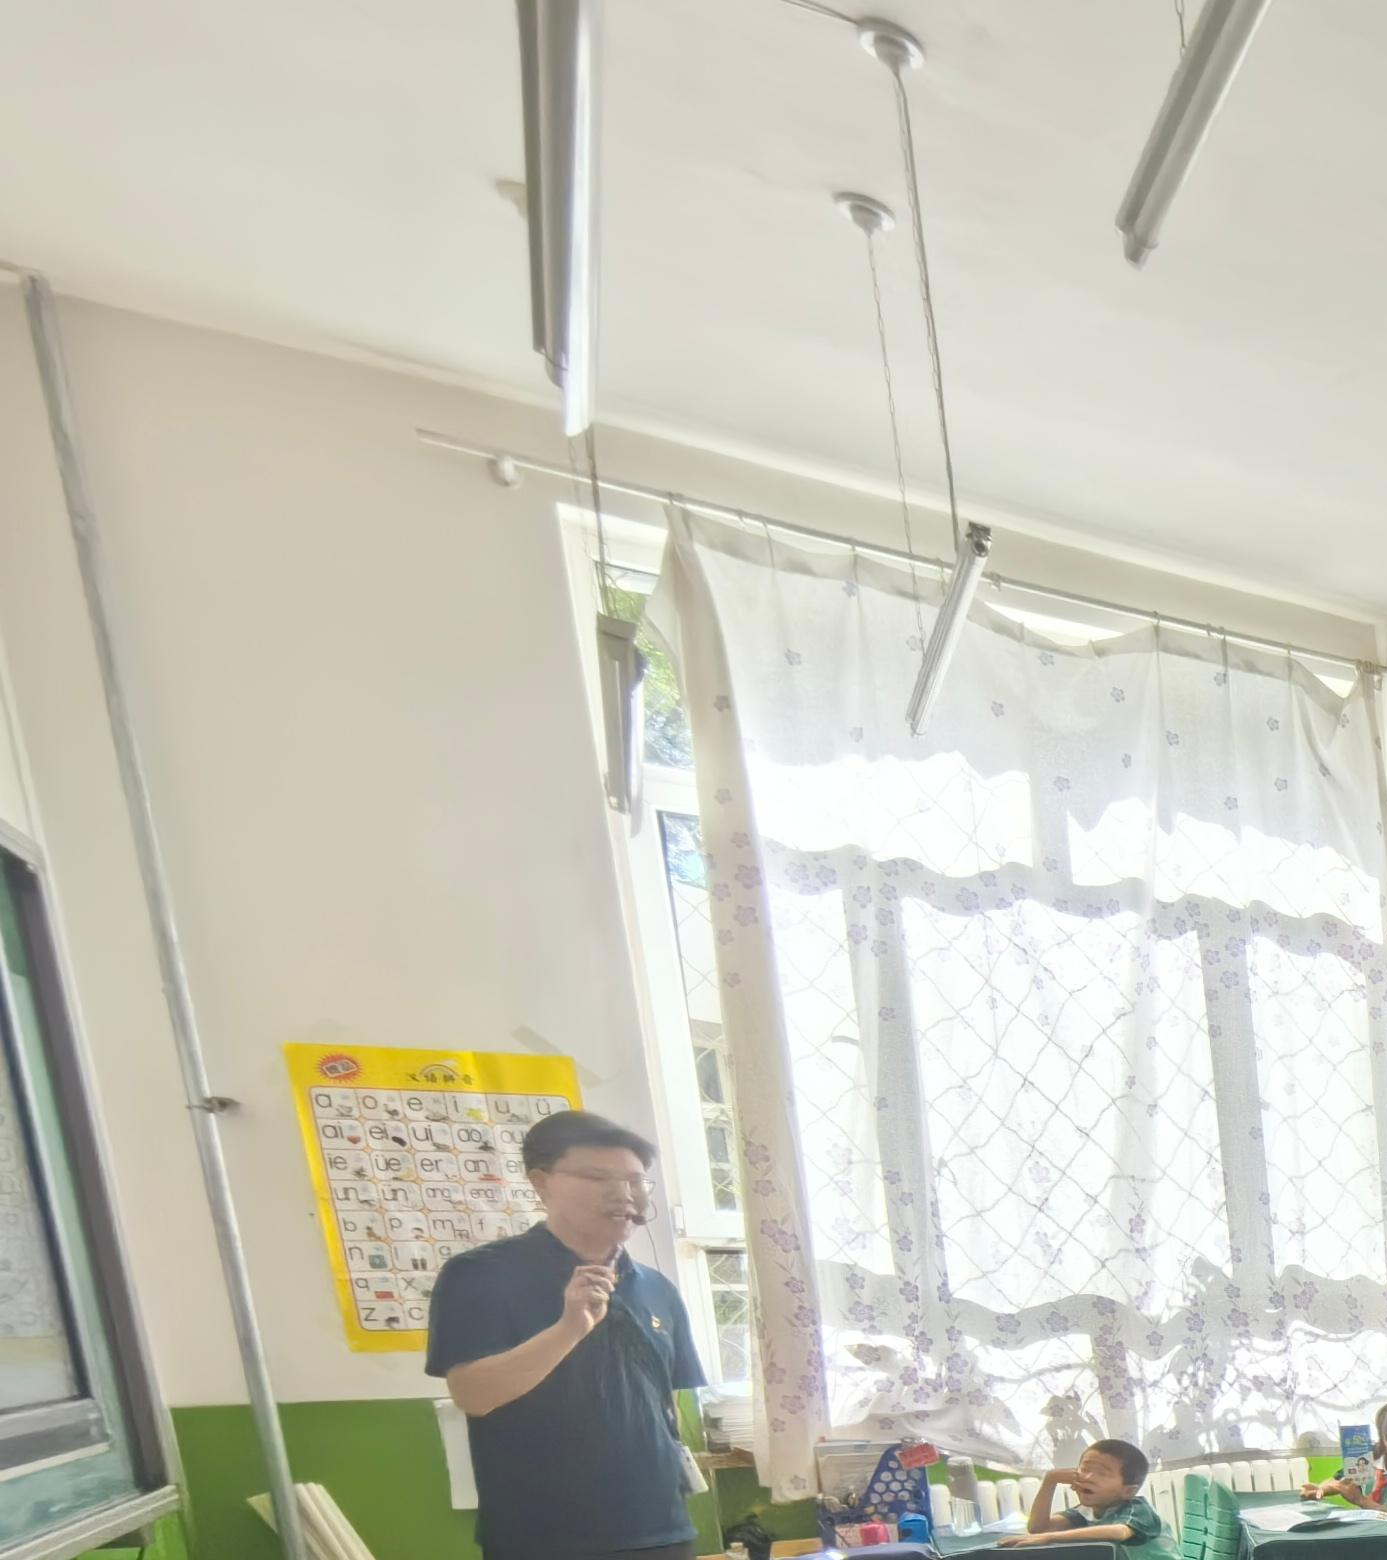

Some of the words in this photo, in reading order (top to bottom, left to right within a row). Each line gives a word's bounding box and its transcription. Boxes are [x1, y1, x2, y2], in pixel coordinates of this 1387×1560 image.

[315, 1093, 332, 1108] a
[362, 1096, 378, 1109] o
[407, 1097, 423, 1112] e
[494, 1100, 510, 1114] u
[321, 1120, 344, 1138] ai
[368, 1122, 389, 1140] ei
[412, 1124, 433, 1142] ui
[457, 1128, 482, 1142] ao
[329, 1155, 347, 1170] ie
[375, 1155, 400, 1172] üe
[420, 1158, 441, 1172] er
[464, 1159, 489, 1173] an
[335, 1186, 360, 1201] un
[344, 1219, 357, 1232] b
[389, 1217, 402, 1233] p
[432, 1218, 454, 1231] m
[349, 1246, 364, 1261] n
[355, 1277, 370, 1292] q
[401, 1277, 418, 1291] x
[360, 1307, 378, 1321] z
[408, 1306, 425, 1321] c
